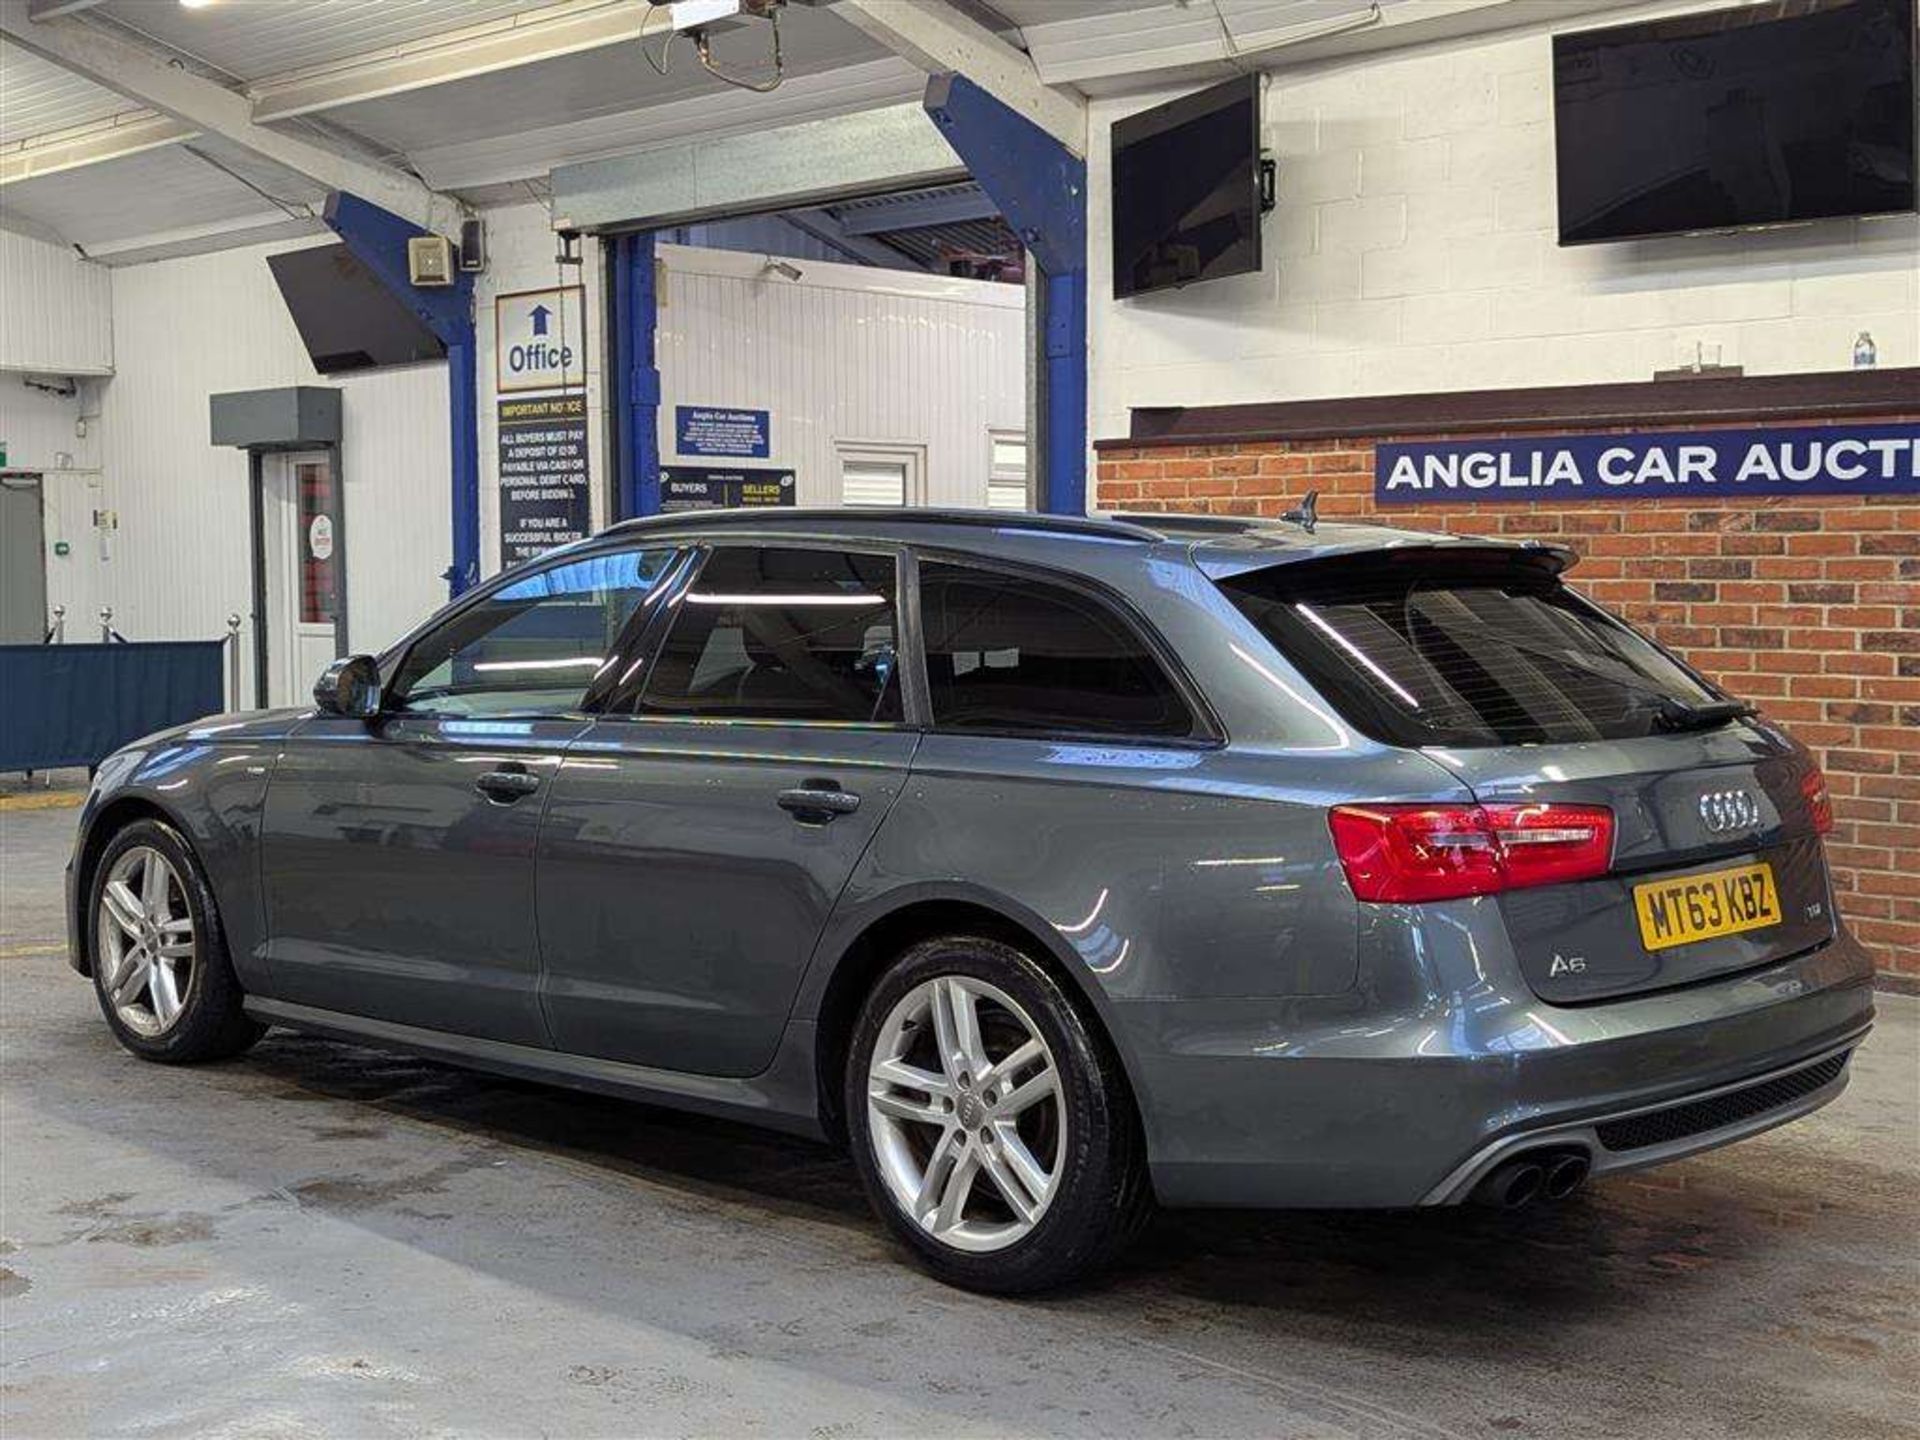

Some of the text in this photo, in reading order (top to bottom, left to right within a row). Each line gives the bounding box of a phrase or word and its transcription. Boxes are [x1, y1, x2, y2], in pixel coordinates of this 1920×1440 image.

[509, 343, 572, 373] Office
[502, 400, 582, 416] IMPORTANT NOICE
[501, 430, 584, 444] ALL BUYERS MUST PAY
[507, 448, 514, 458] A
[515, 446, 546, 458] DEPOSIT
[547, 446, 557, 456] OF
[502, 461, 535, 473] PAYABLE
[572, 459, 584, 470] OR
[1385, 450, 1584, 489] ANGLIA
[1597, 446, 1717, 485] CAR
[500, 475, 539, 487] PERSONAL
[540, 475, 561, 486] DEBIT
[511, 489, 539, 501] BEFORE
[671, 482, 780, 495] BUYERS SELLERS
[519, 518, 527, 529] IF
[527, 518, 544, 529] YOU
[545, 517, 561, 528] ARE
[504, 532, 552, 543] SUCCESSFUL
[1648, 873, 1771, 938] MT63 KBZ
[1550, 953, 1586, 977] A6
